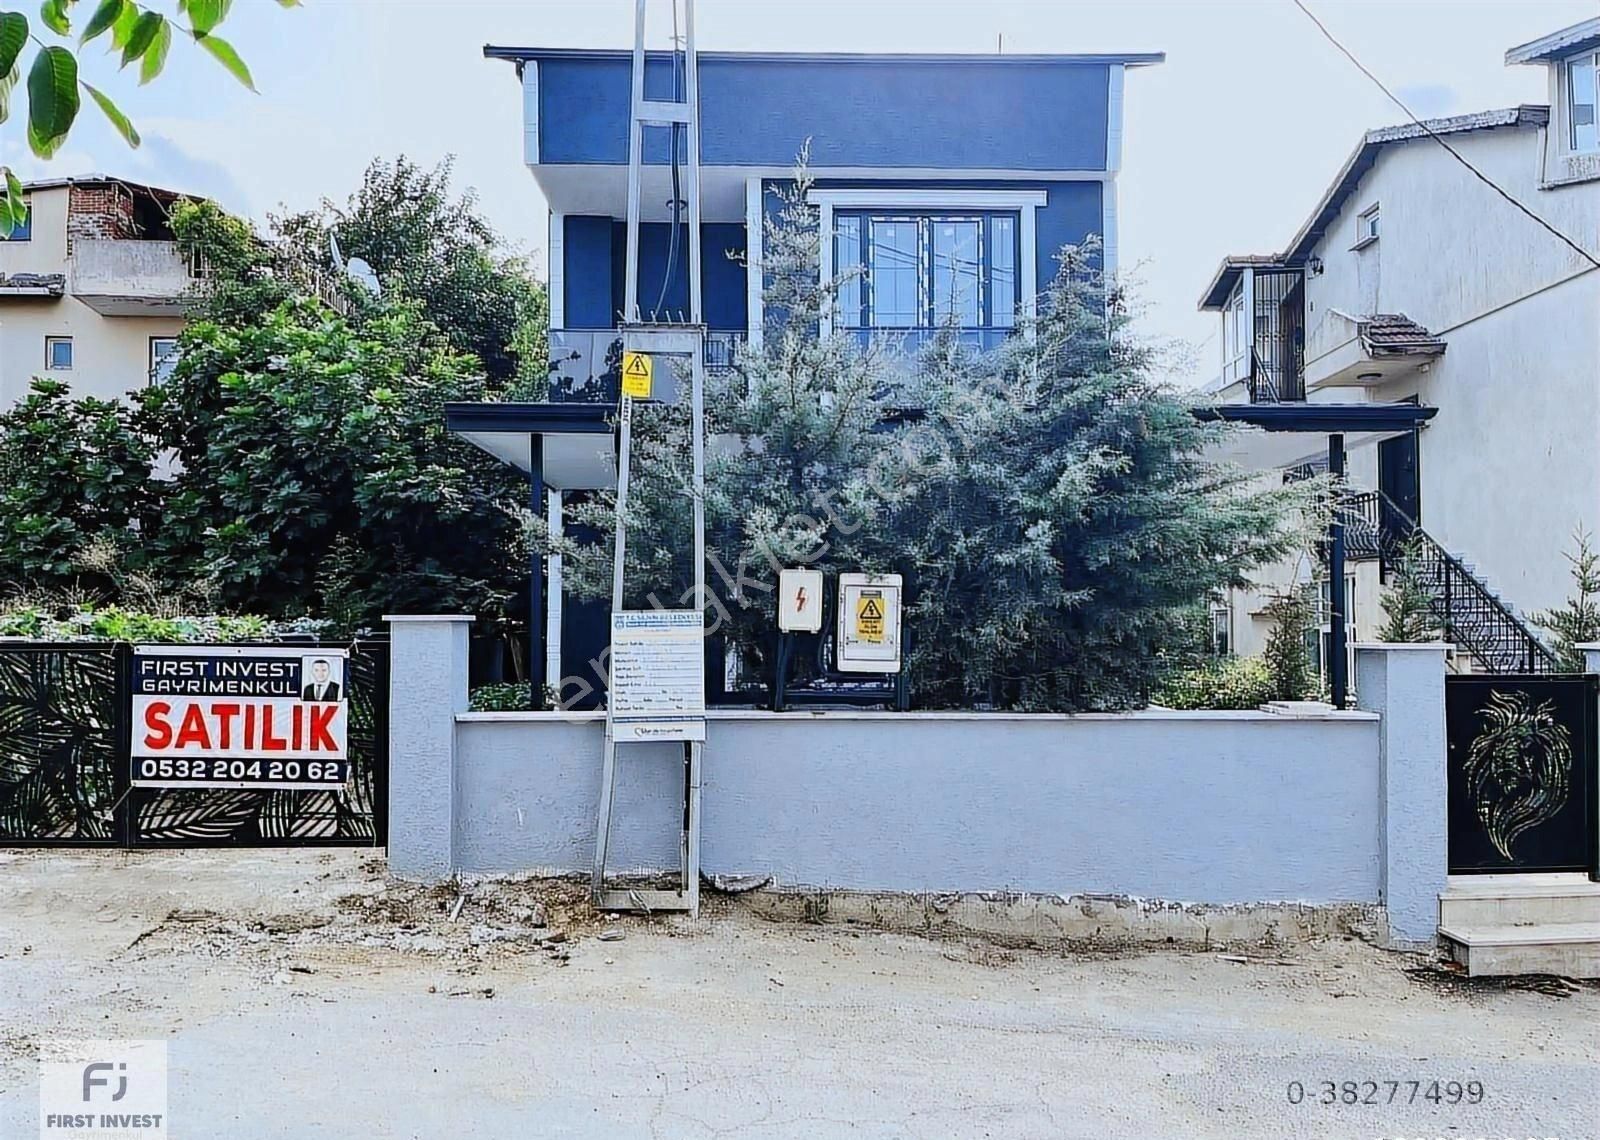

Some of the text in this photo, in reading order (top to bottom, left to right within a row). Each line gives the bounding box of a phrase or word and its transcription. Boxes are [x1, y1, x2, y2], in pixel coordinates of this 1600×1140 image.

[141, 660, 299, 677] FIRST INVEST
[142, 678, 298, 694] GAYRİMENKUL
[144, 702, 339, 751] SATILIK
[141, 759, 339, 780] 0532 204 20 62
